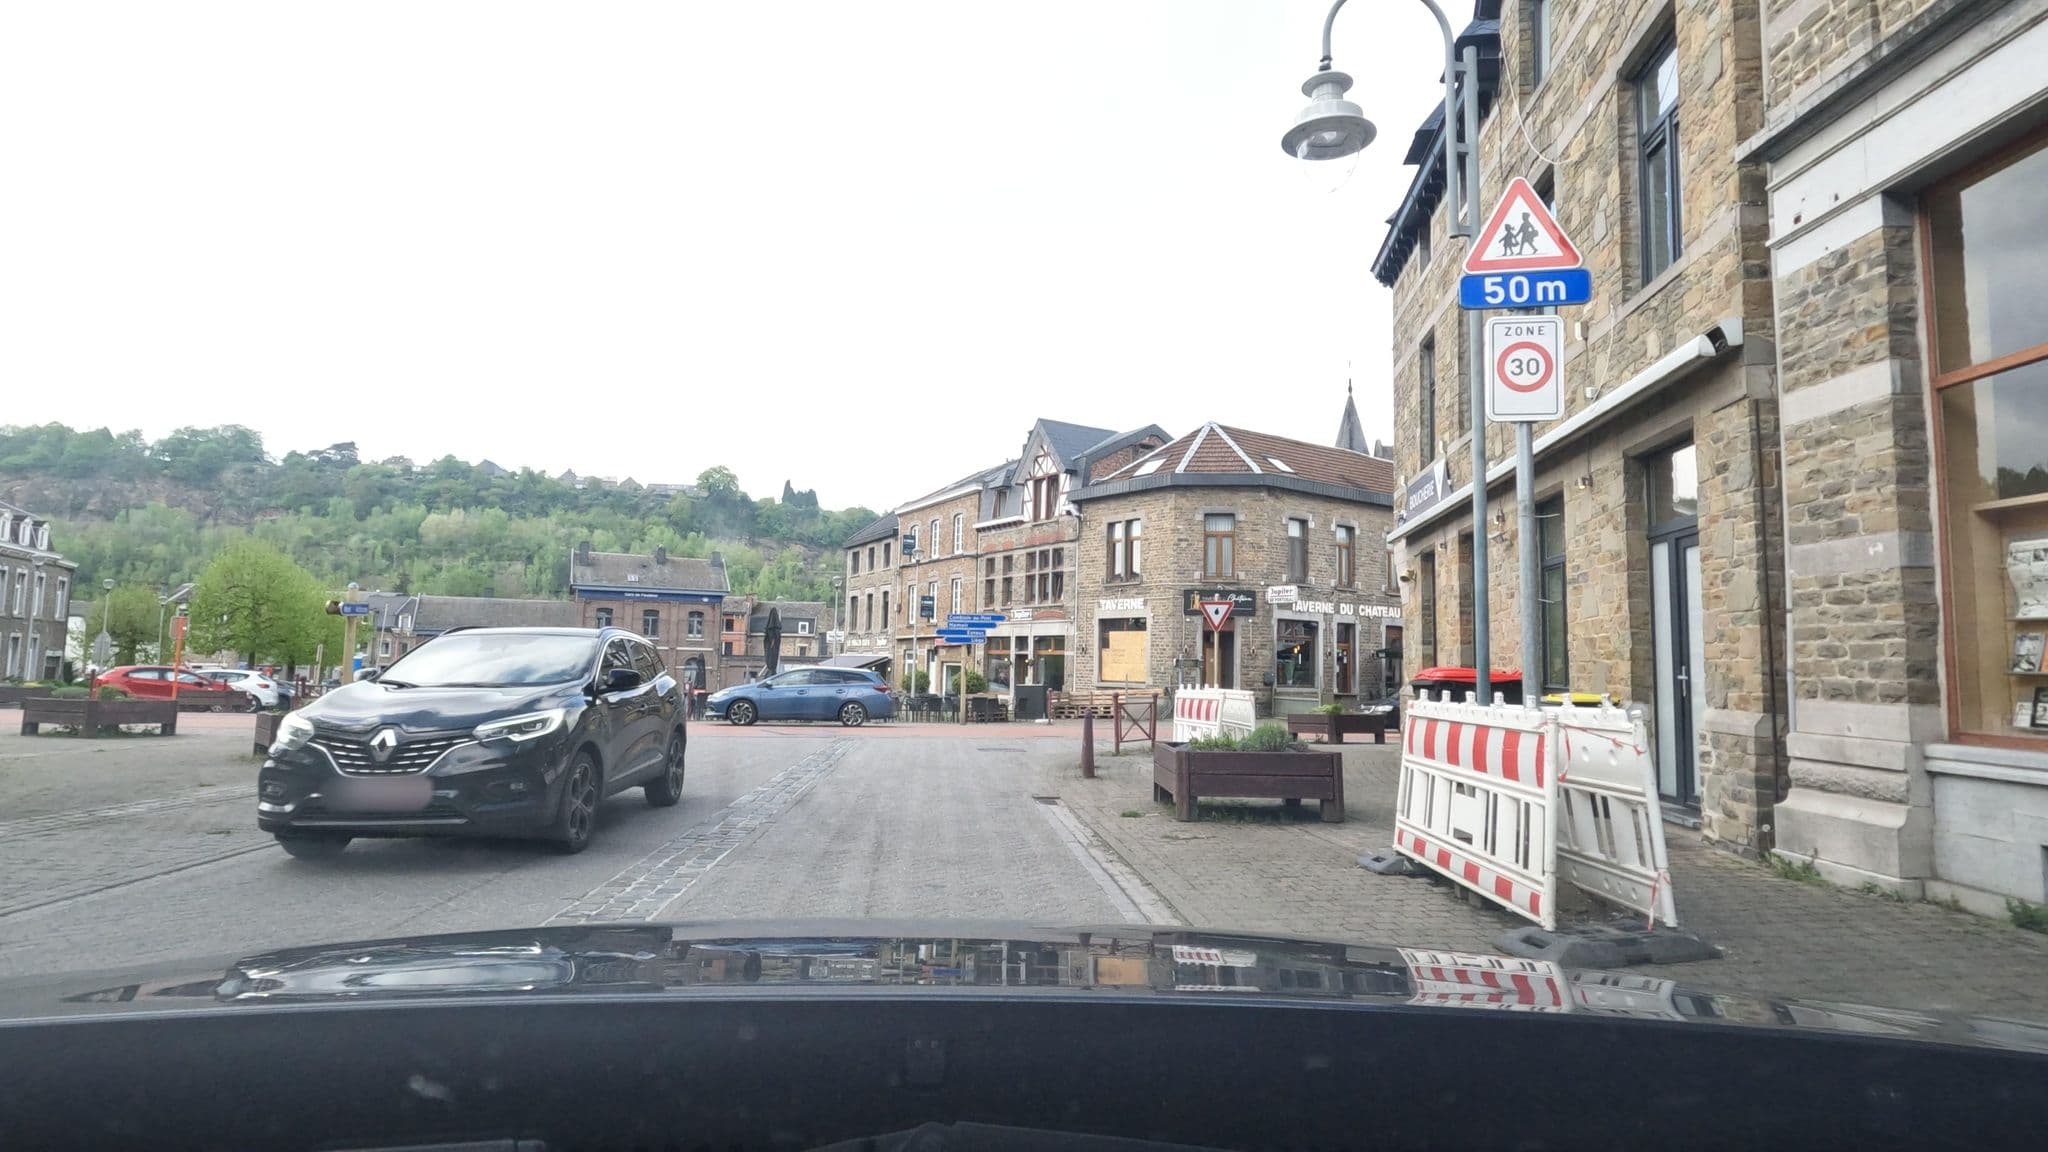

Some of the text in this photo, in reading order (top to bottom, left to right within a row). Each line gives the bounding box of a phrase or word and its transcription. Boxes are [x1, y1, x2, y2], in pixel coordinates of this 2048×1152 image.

[1484, 275, 1567, 304] 50 m
[1504, 325, 1546, 337] ZONE
[1510, 358, 1540, 376] 30
[1409, 479, 1434, 511] BOUCHERIE
[1271, 588, 1294, 596] Jupiler
[1100, 598, 1145, 610] TAVERNE
[1340, 603, 1354, 615] DU
[1358, 605, 1400, 618] CHATEAU
